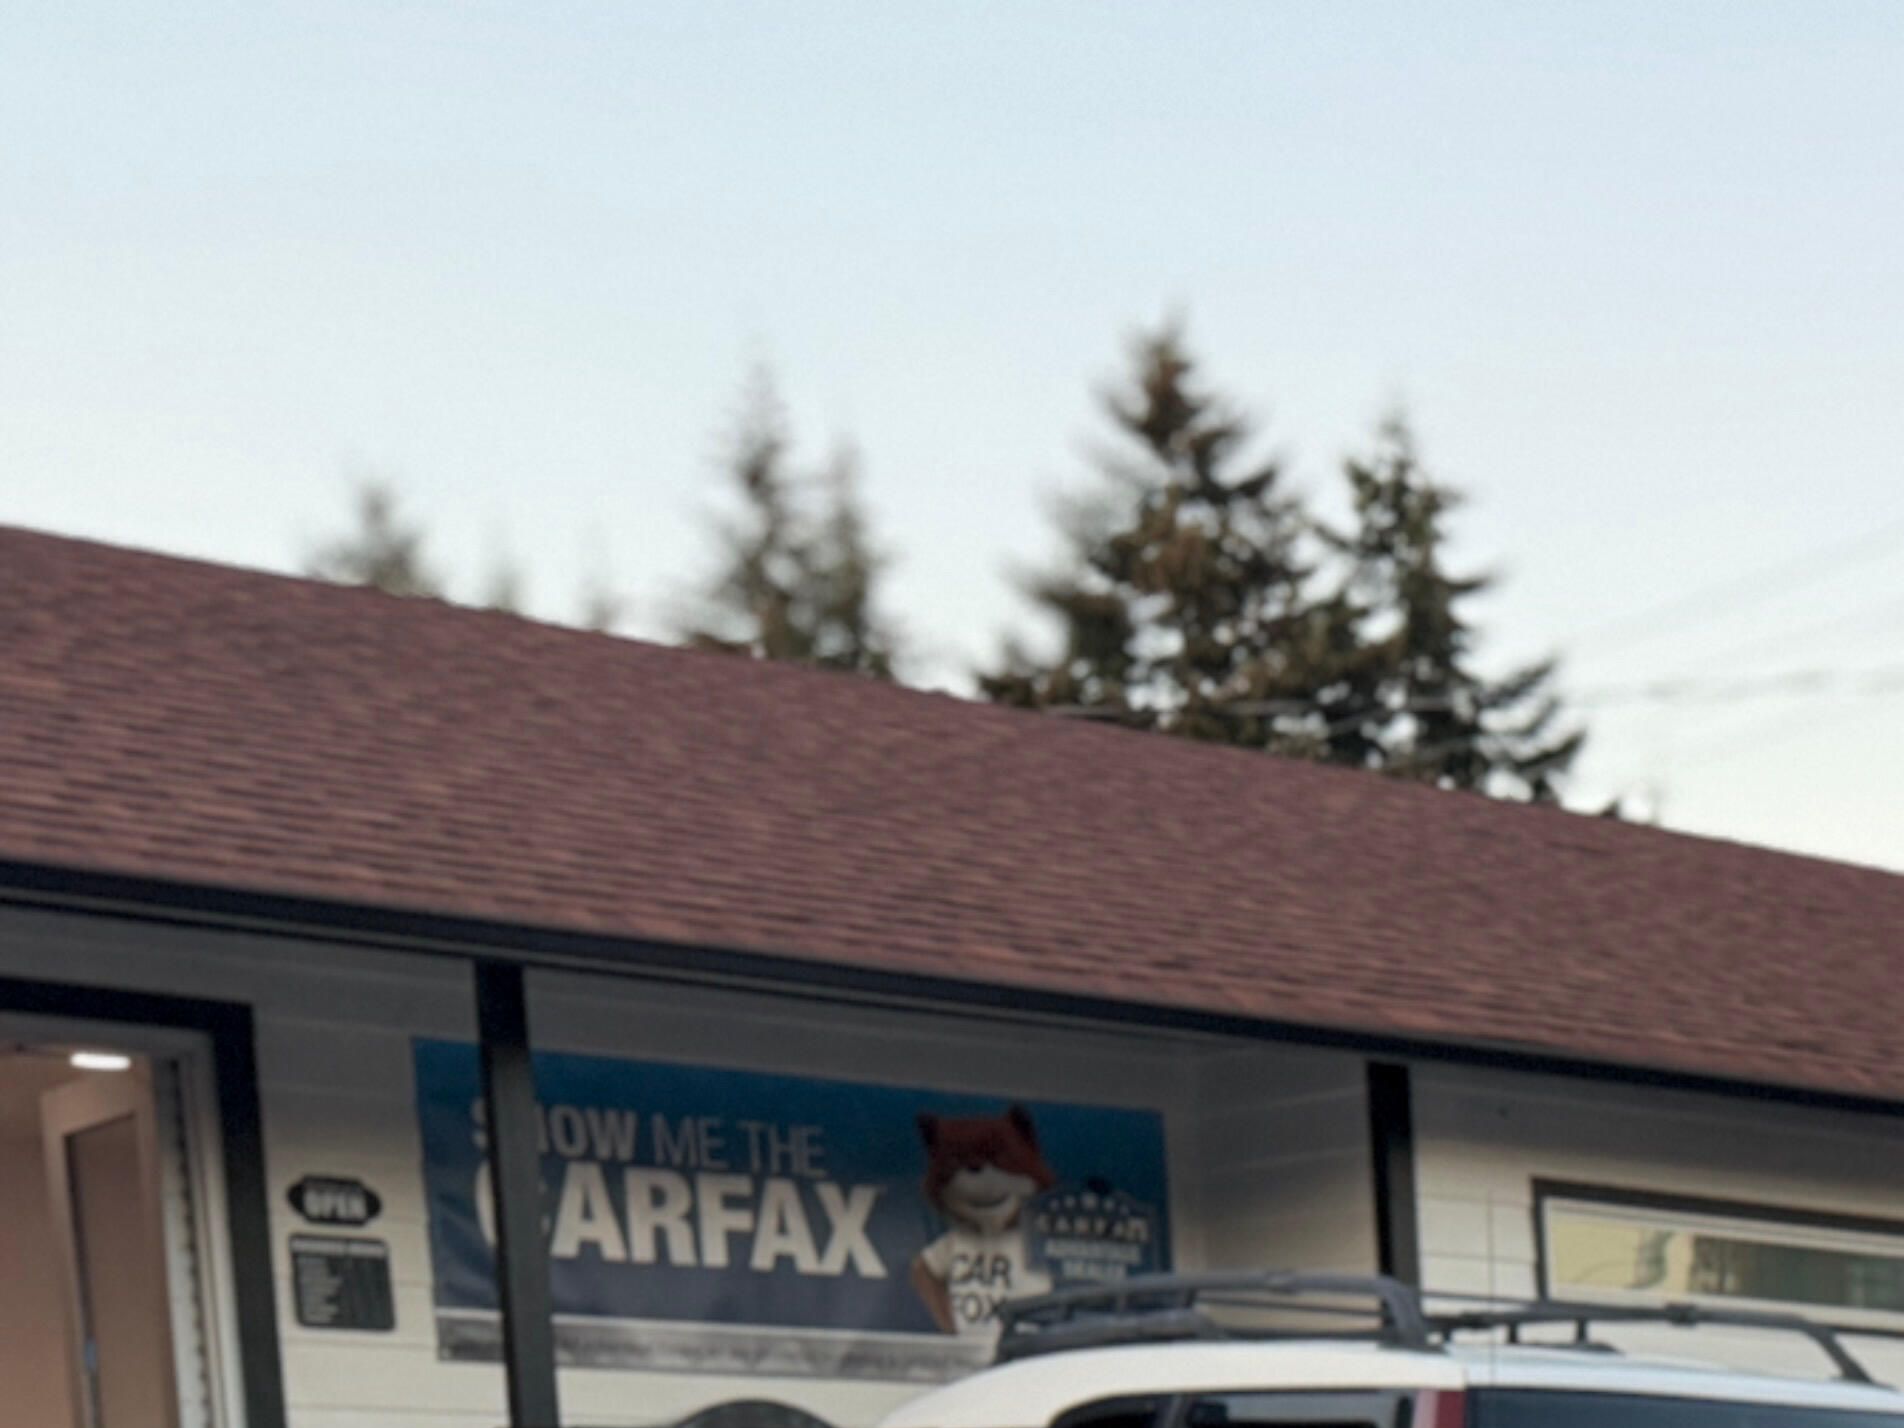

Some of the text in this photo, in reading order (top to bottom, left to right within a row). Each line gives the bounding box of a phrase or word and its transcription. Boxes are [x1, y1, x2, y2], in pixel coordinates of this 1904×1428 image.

[652, 1113, 730, 1170] ME
[736, 1119, 827, 1179] THE
[951, 1254, 1012, 1289] CAR
